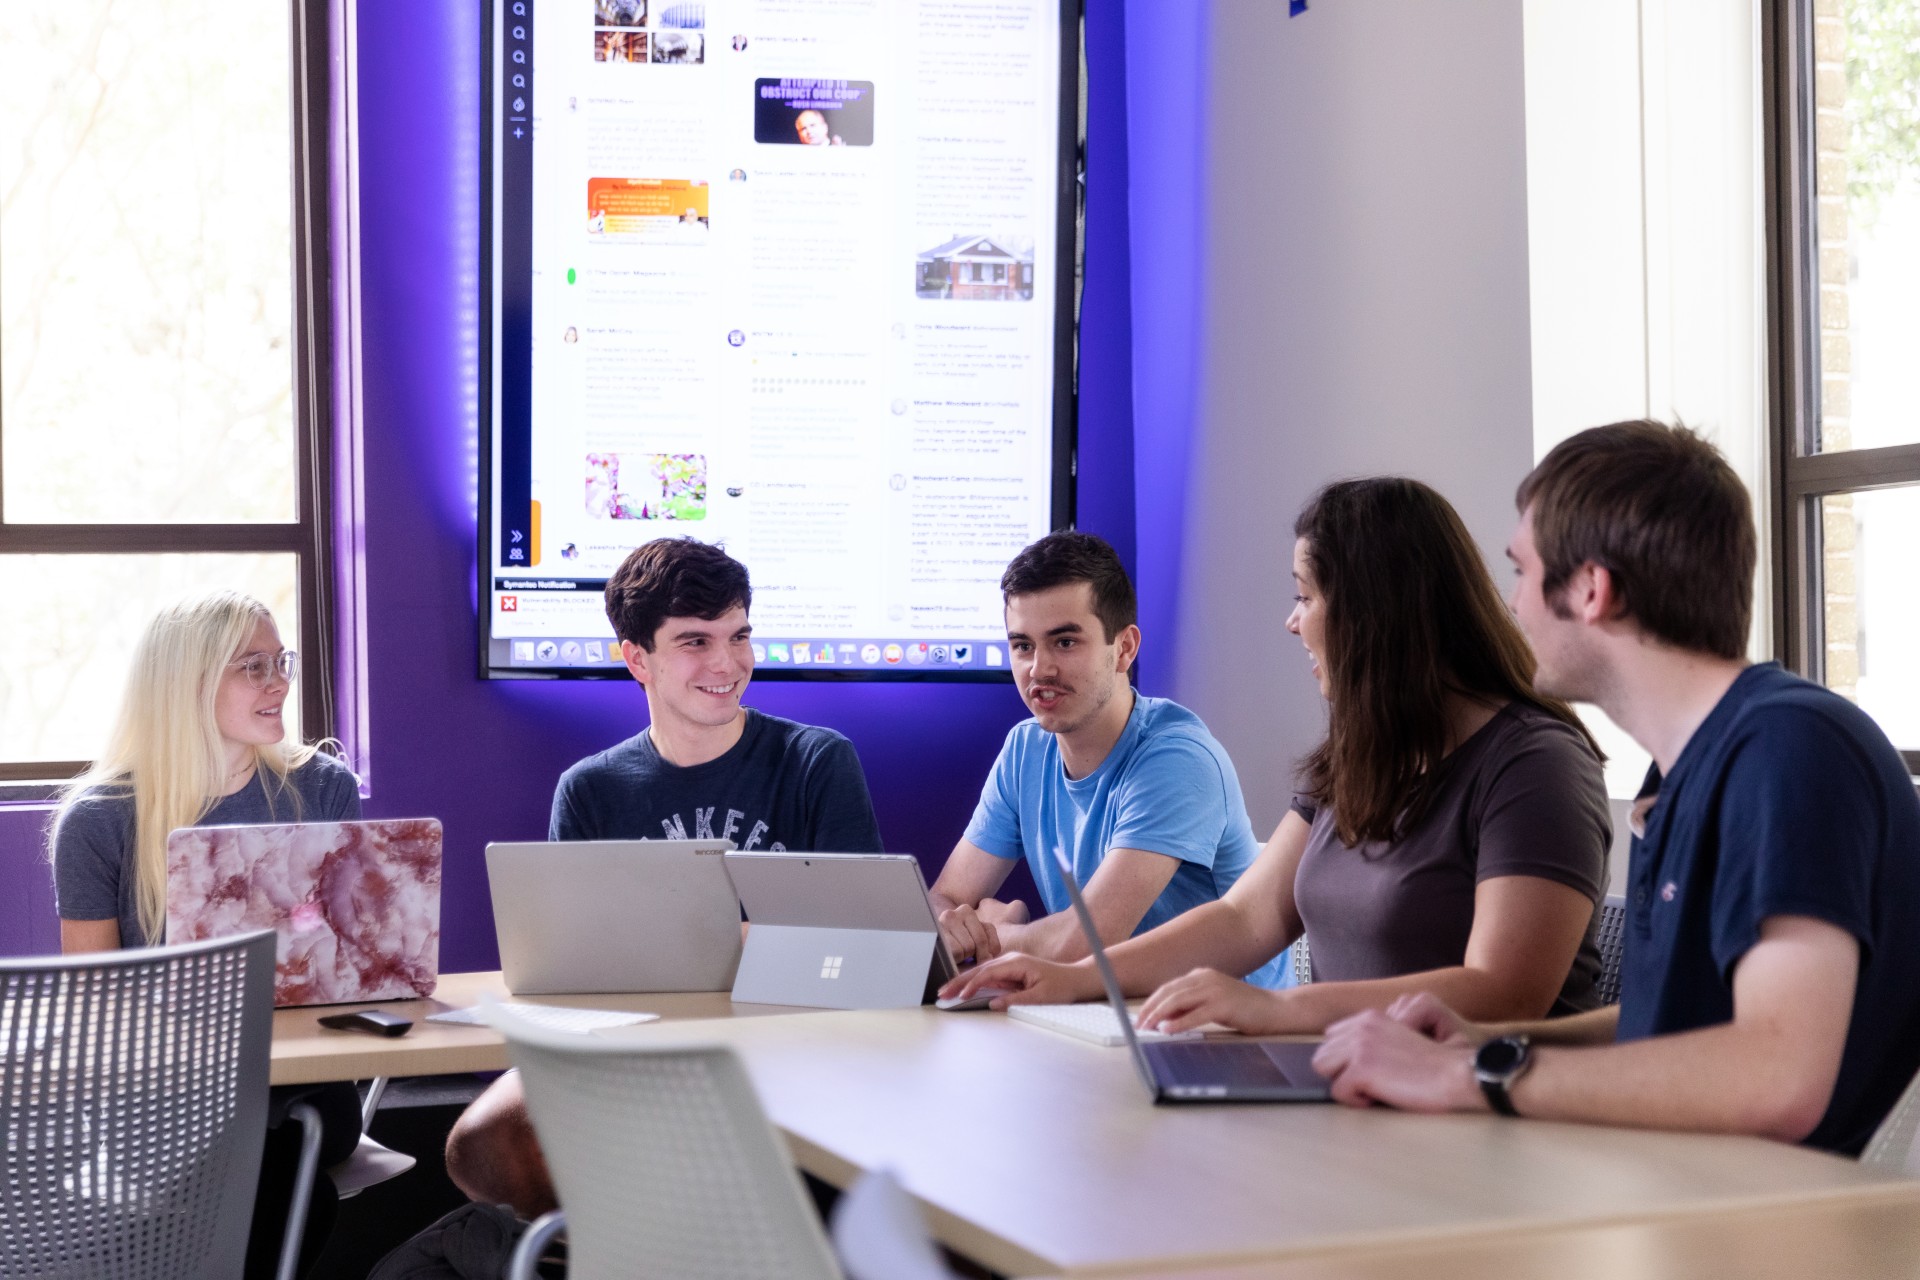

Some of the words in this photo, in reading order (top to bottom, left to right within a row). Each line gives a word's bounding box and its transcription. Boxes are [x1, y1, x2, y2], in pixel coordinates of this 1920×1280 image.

[760, 86, 811, 99] OBSTRUCT
[812, 87, 833, 100] OUR
[639, 806, 787, 852] NKEE
